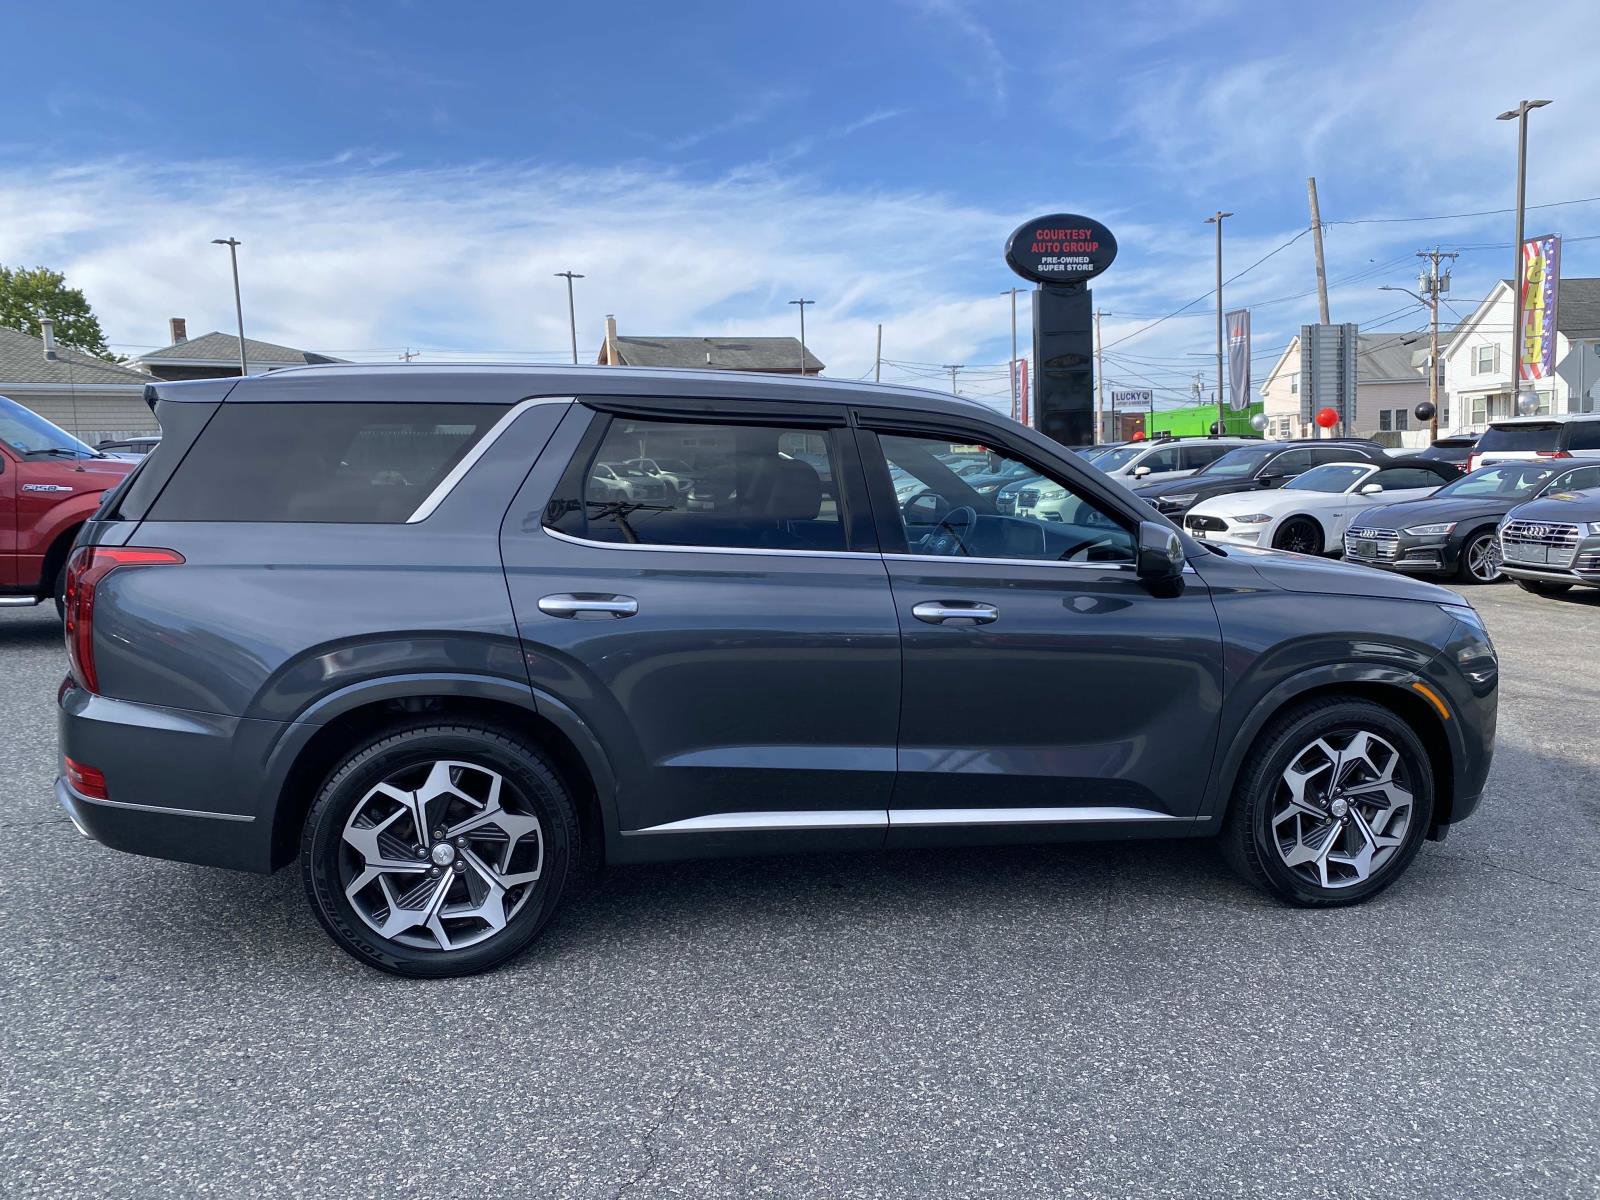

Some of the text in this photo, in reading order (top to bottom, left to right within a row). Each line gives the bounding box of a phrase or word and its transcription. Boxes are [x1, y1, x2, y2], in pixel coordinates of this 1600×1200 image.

[1036, 229, 1092, 240] COURTESY
[1031, 242, 1099, 253] AUTO GROUP
[1115, 392, 1141, 401] LUCKY
[341, 928, 384, 960] TOYO
